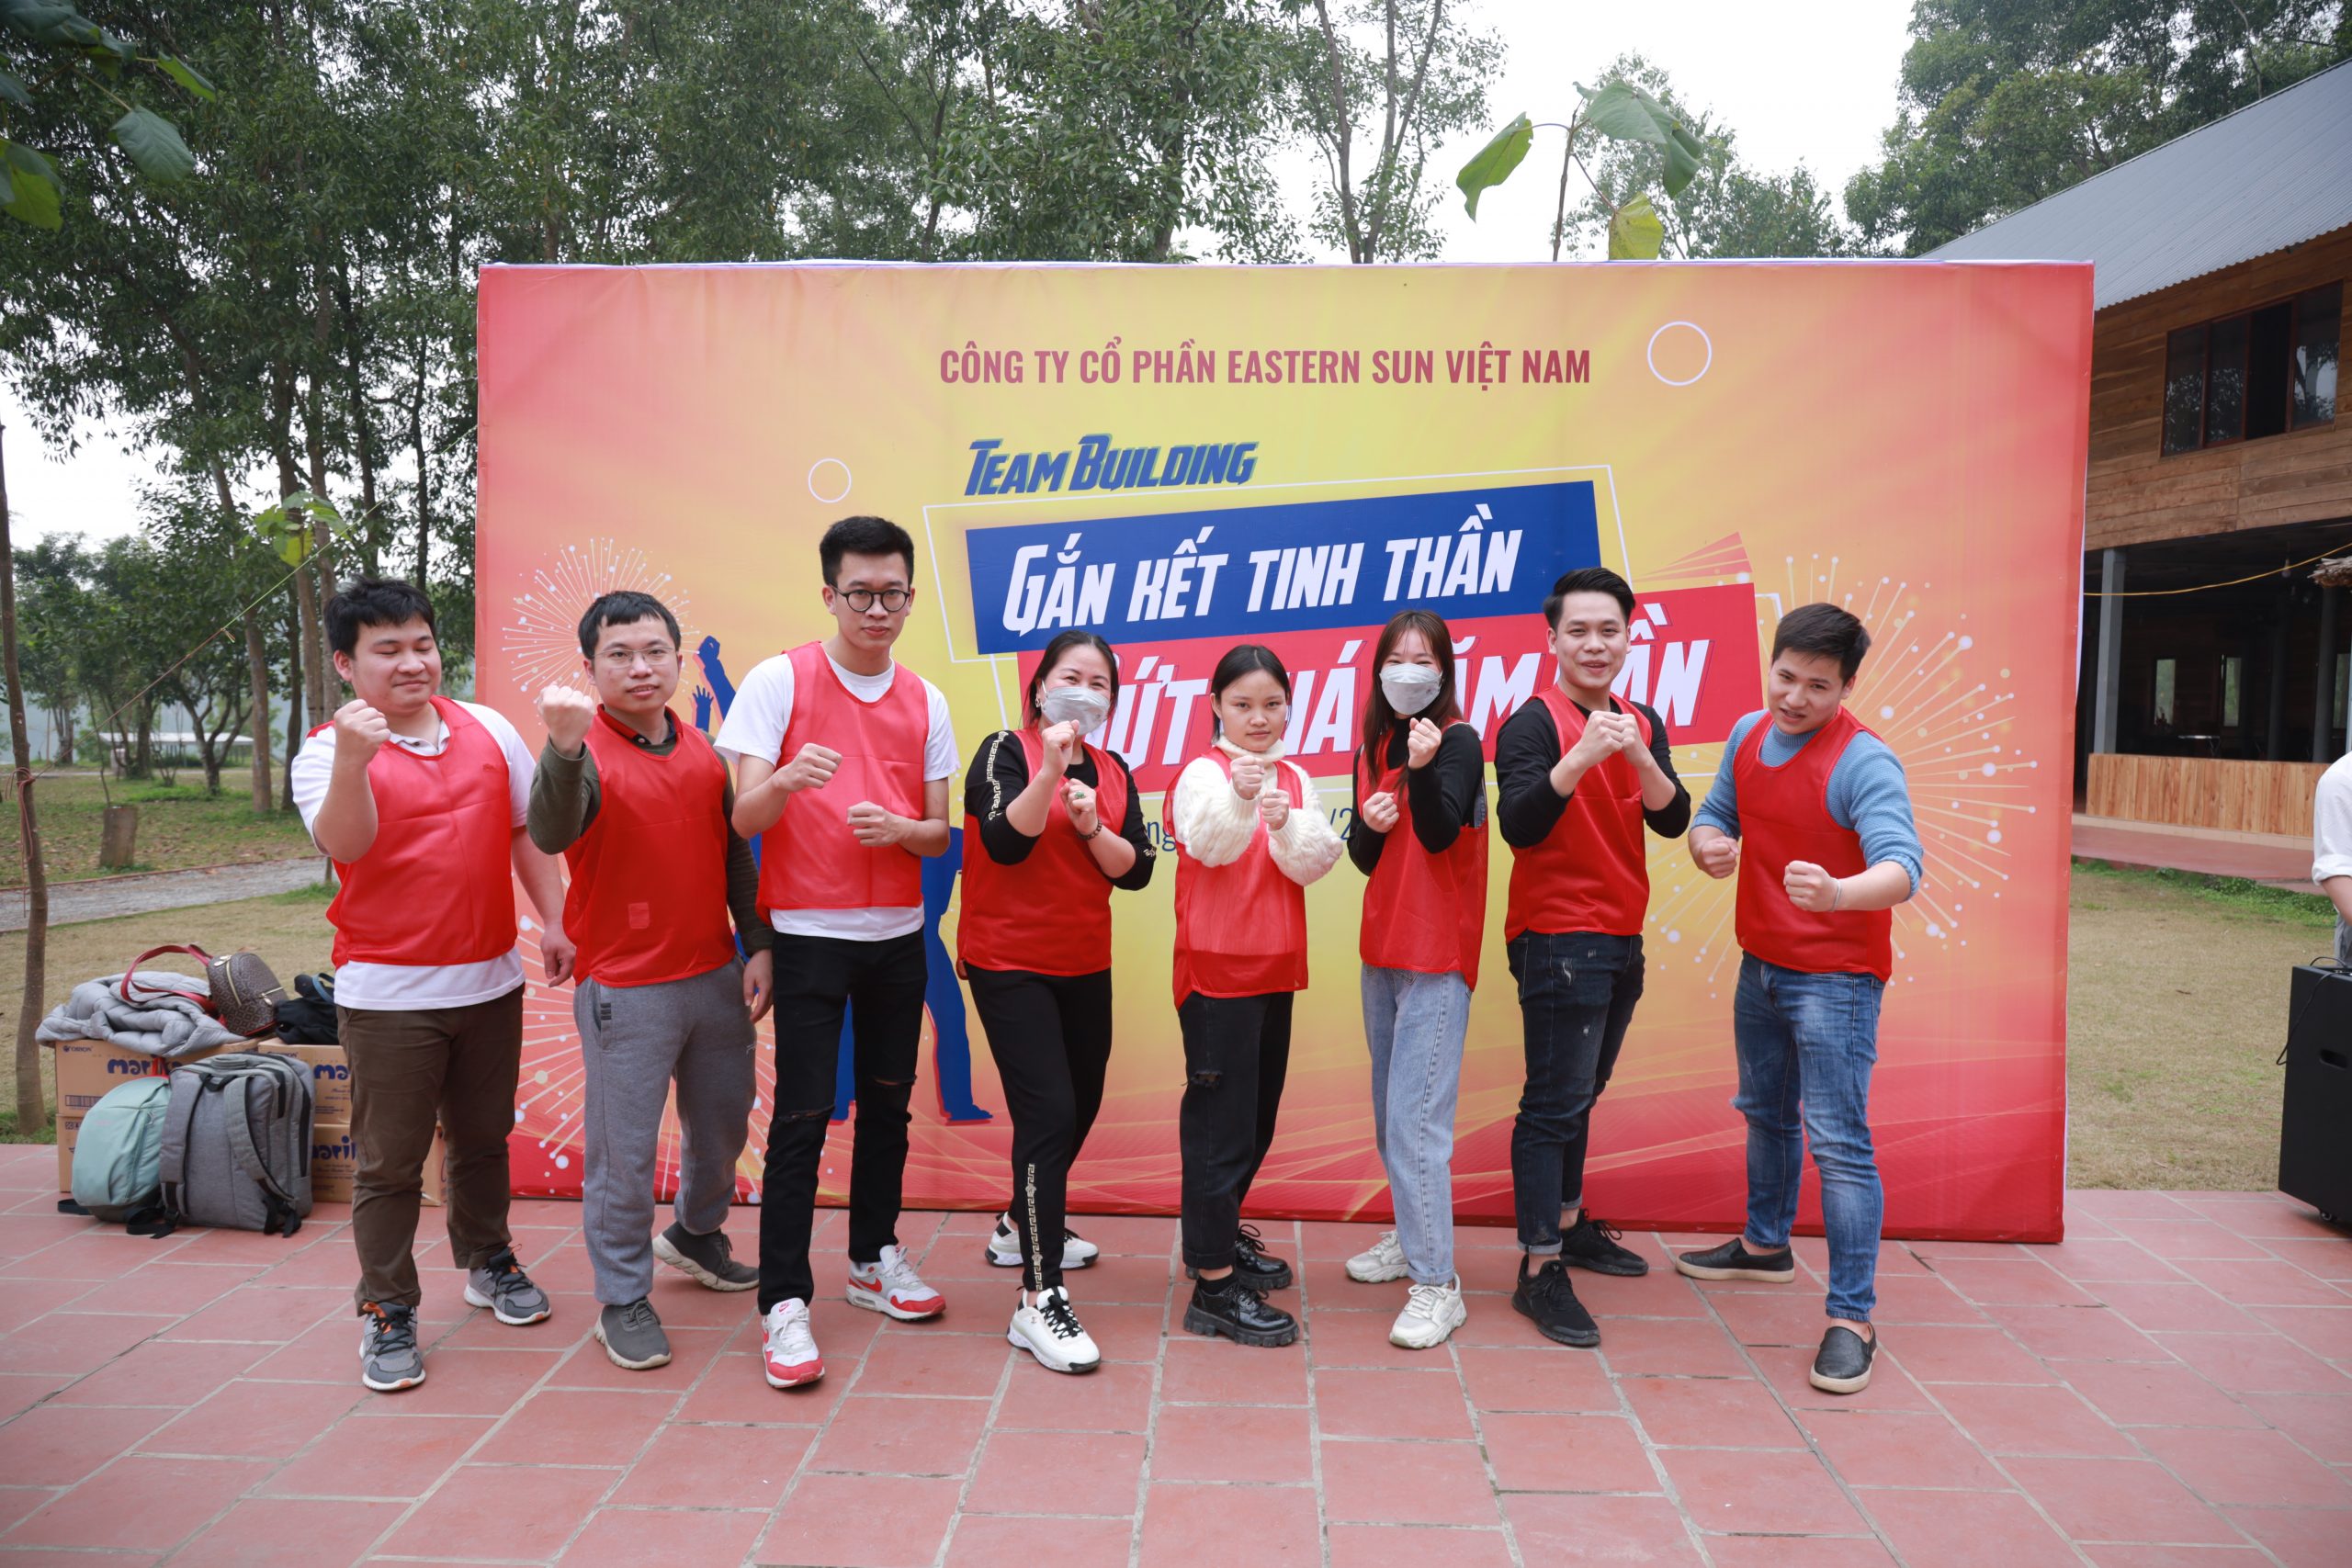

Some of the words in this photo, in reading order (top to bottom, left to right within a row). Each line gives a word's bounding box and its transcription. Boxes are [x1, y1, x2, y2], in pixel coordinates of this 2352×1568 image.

[940, 341, 1023, 384] CÔNG
[1034, 350, 1069, 384] TY
[1080, 336, 1122, 384] CỔ
[1132, 338, 1216, 384] PHẦN
[1227, 349, 1360, 384] EASTERN
[1372, 349, 1433, 384] SUN
[1445, 341, 1511, 391] VIỆT
[1522, 349, 1590, 384] NAM
[1003, 532, 1116, 637] GẮN
[1126, 525, 1229, 623] KẾT
[1246, 542, 1365, 613] TINH
[1383, 503, 1523, 602] THẦN
[1084, 653, 1209, 774] ỨT
